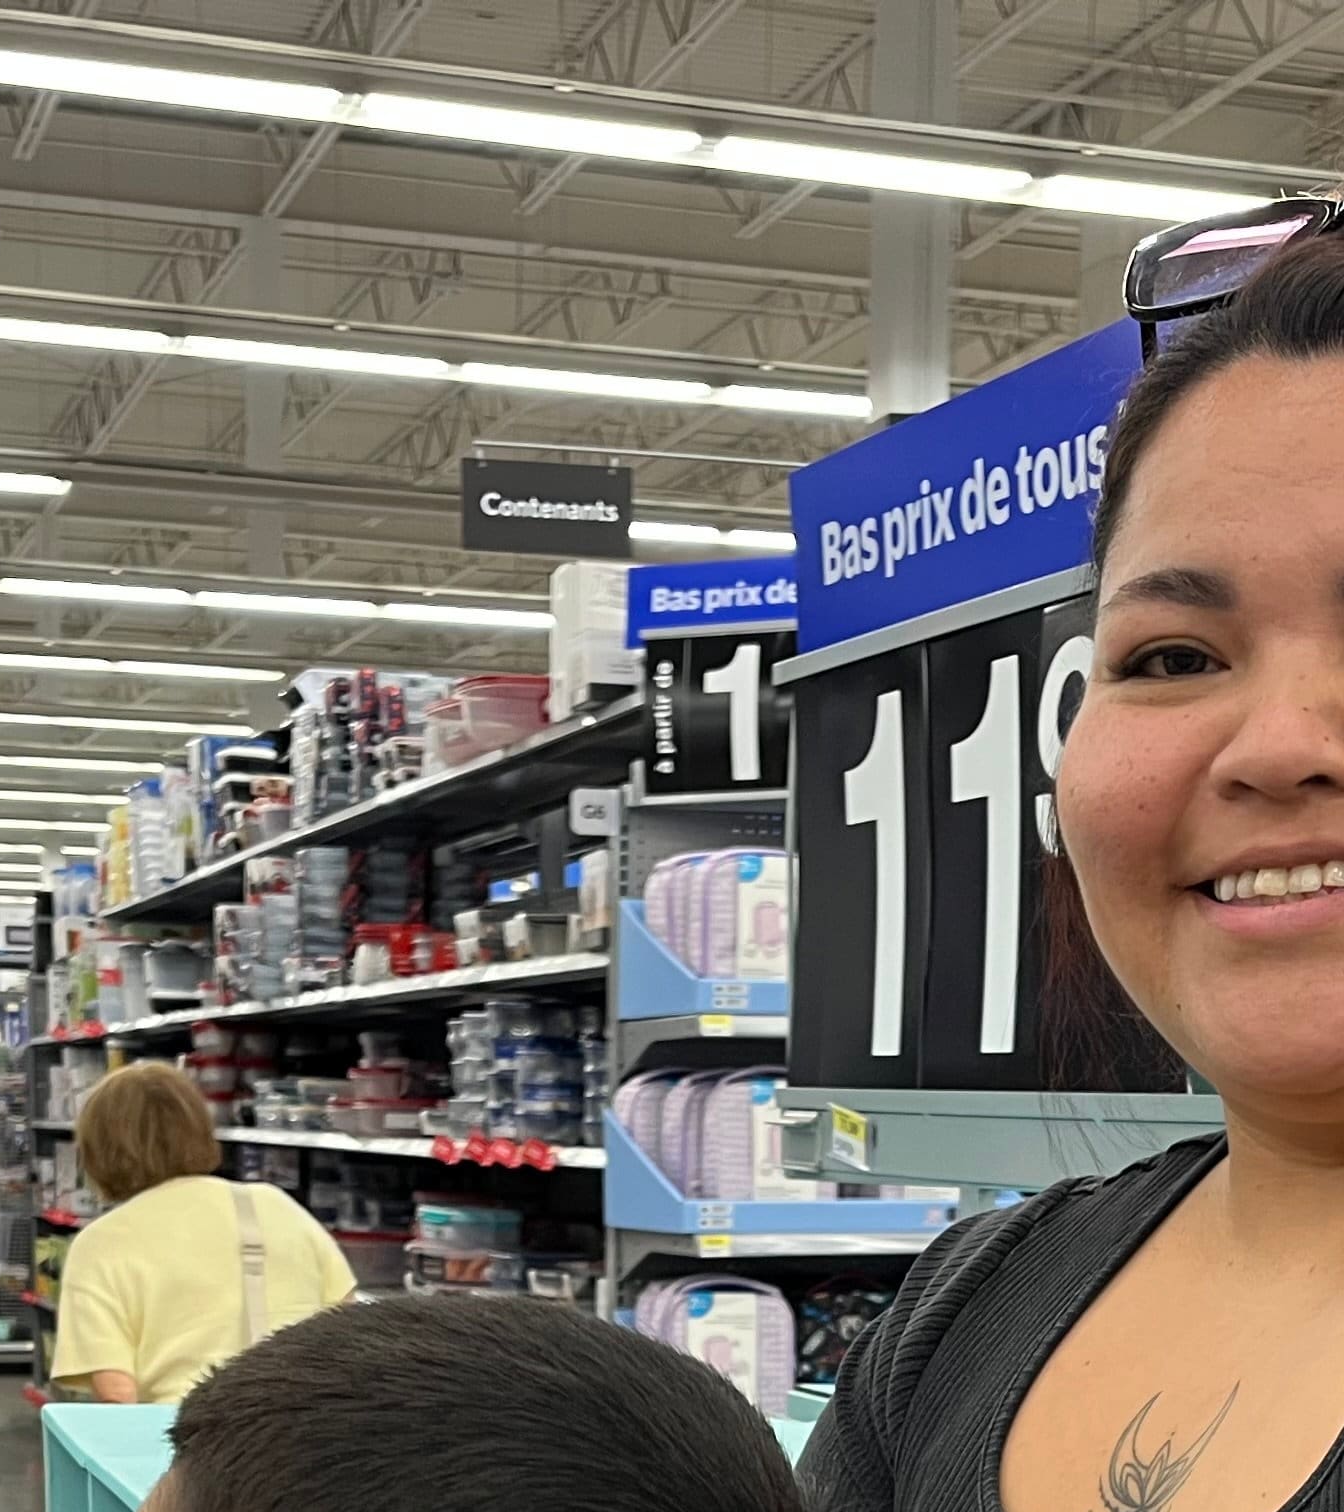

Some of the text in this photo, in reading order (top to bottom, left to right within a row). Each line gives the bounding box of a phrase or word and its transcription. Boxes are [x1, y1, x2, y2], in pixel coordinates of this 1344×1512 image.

[479, 491, 620, 523] Contenants
[820, 424, 1105, 588] Bas prix de tous
[650, 587, 702, 613] Bas
[702, 580, 764, 614] prix
[703, 644, 761, 781] 1
